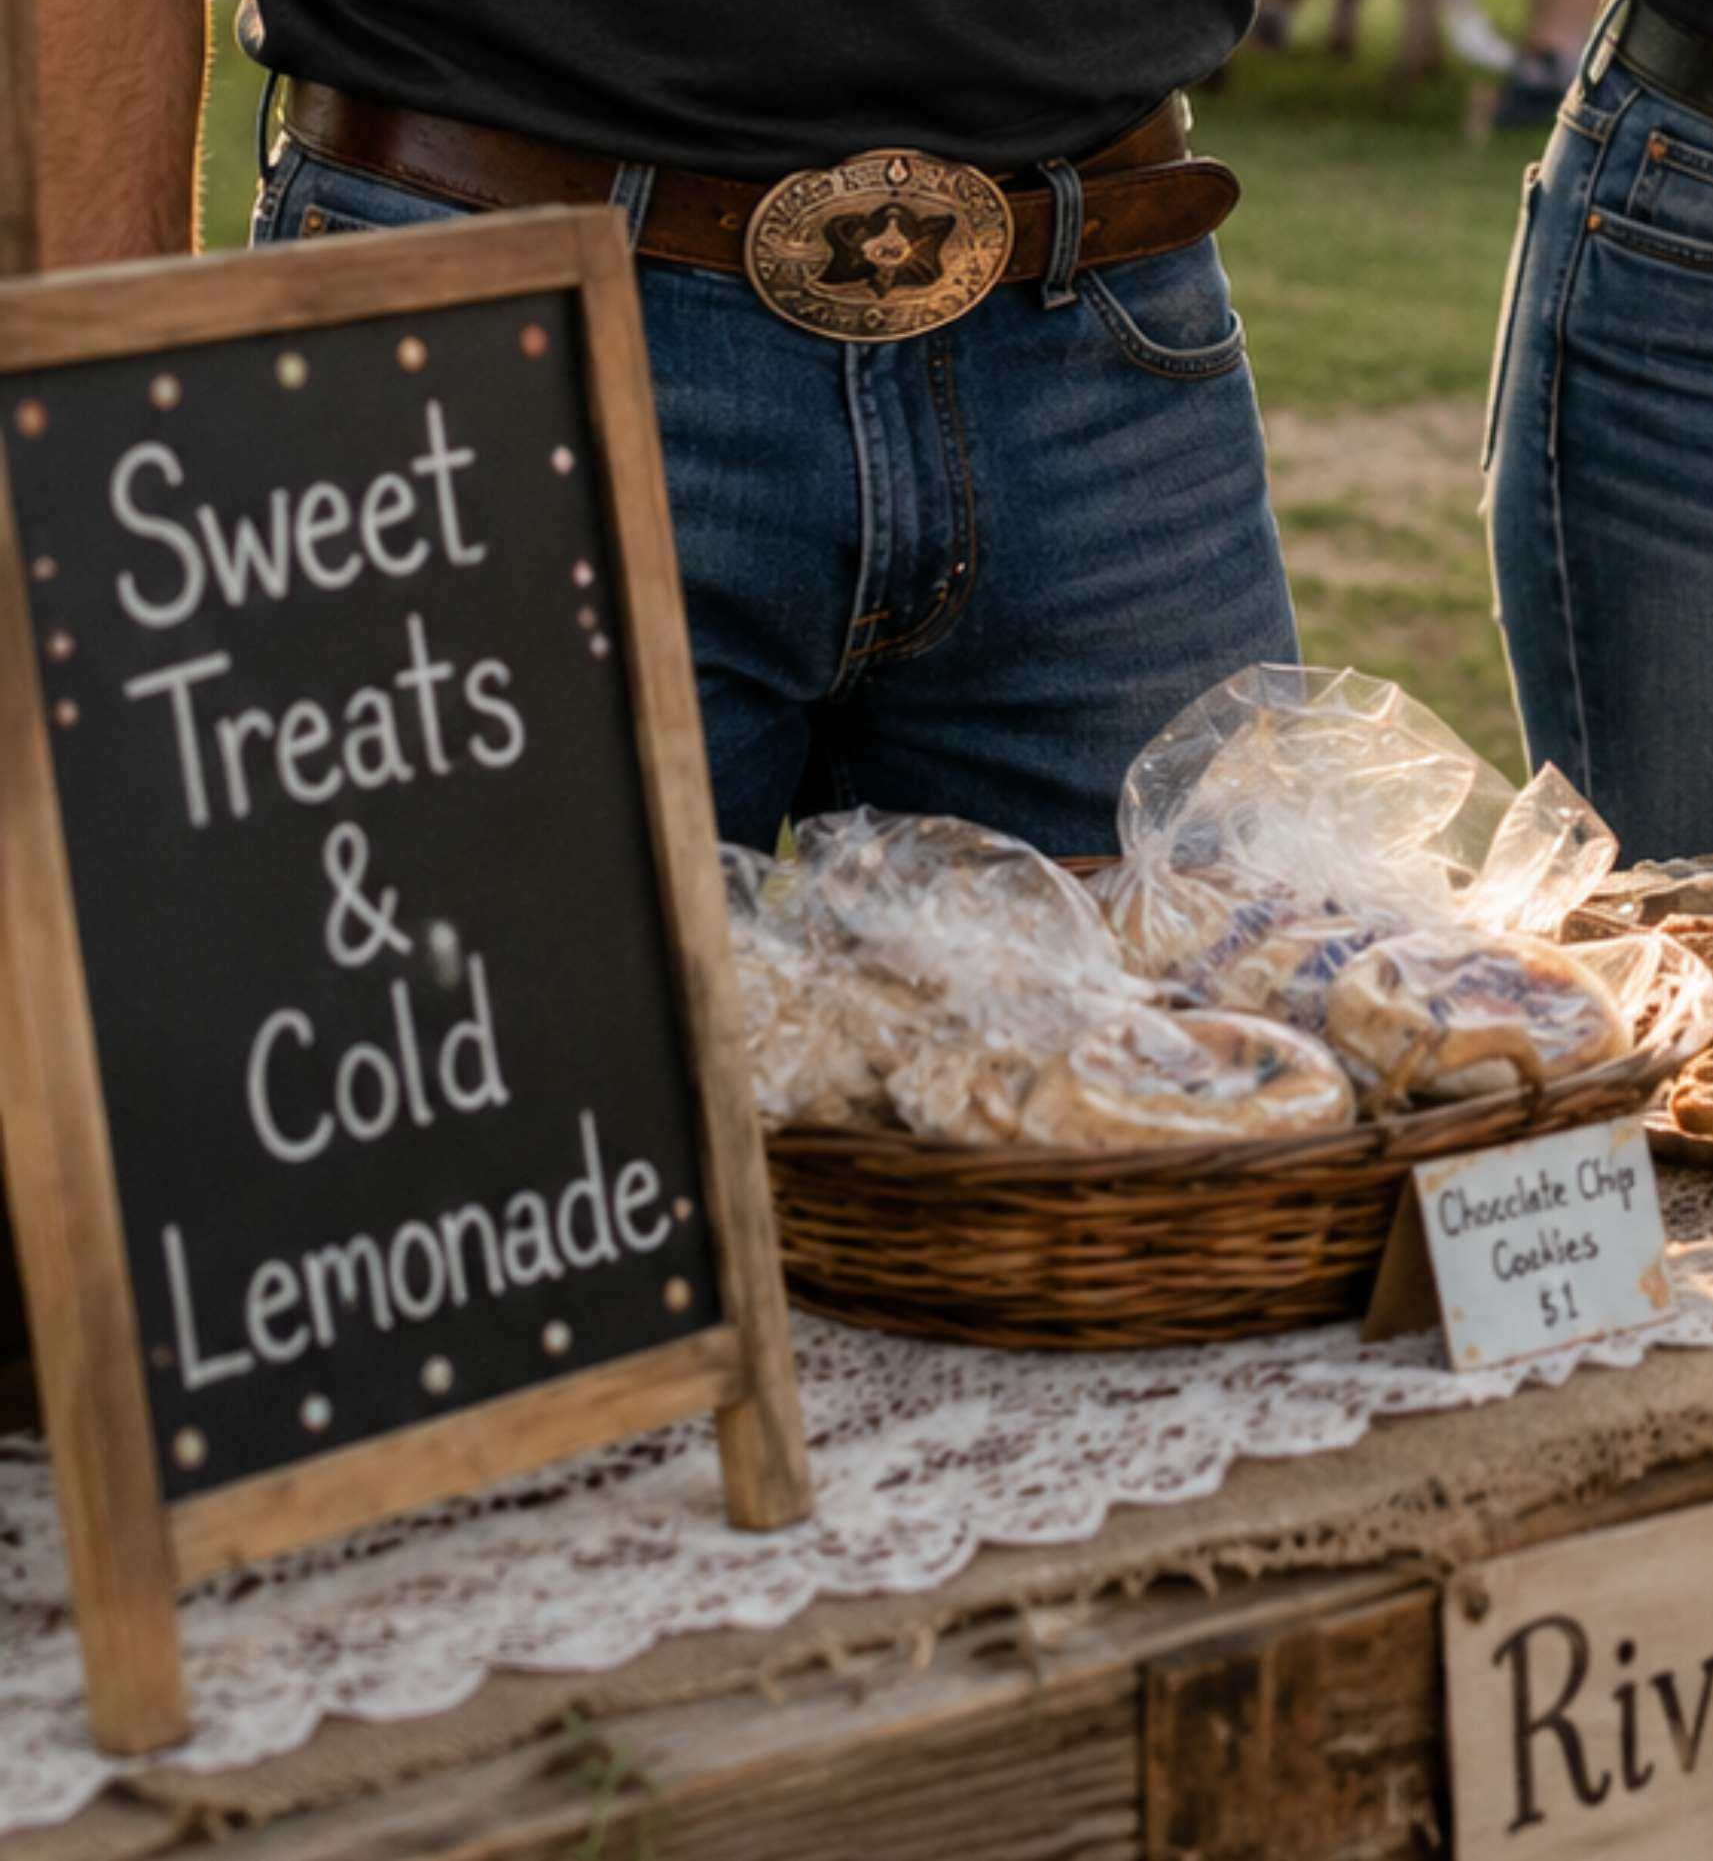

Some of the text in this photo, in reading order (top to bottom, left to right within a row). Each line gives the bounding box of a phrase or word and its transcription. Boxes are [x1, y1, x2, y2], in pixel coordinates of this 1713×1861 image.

[110, 399, 486, 628] Sweet
[123, 612, 526, 828] Treats
[324, 821, 412, 966] &
[246, 953, 510, 1162] Cold
[163, 1109, 672, 1389] Lemonade
